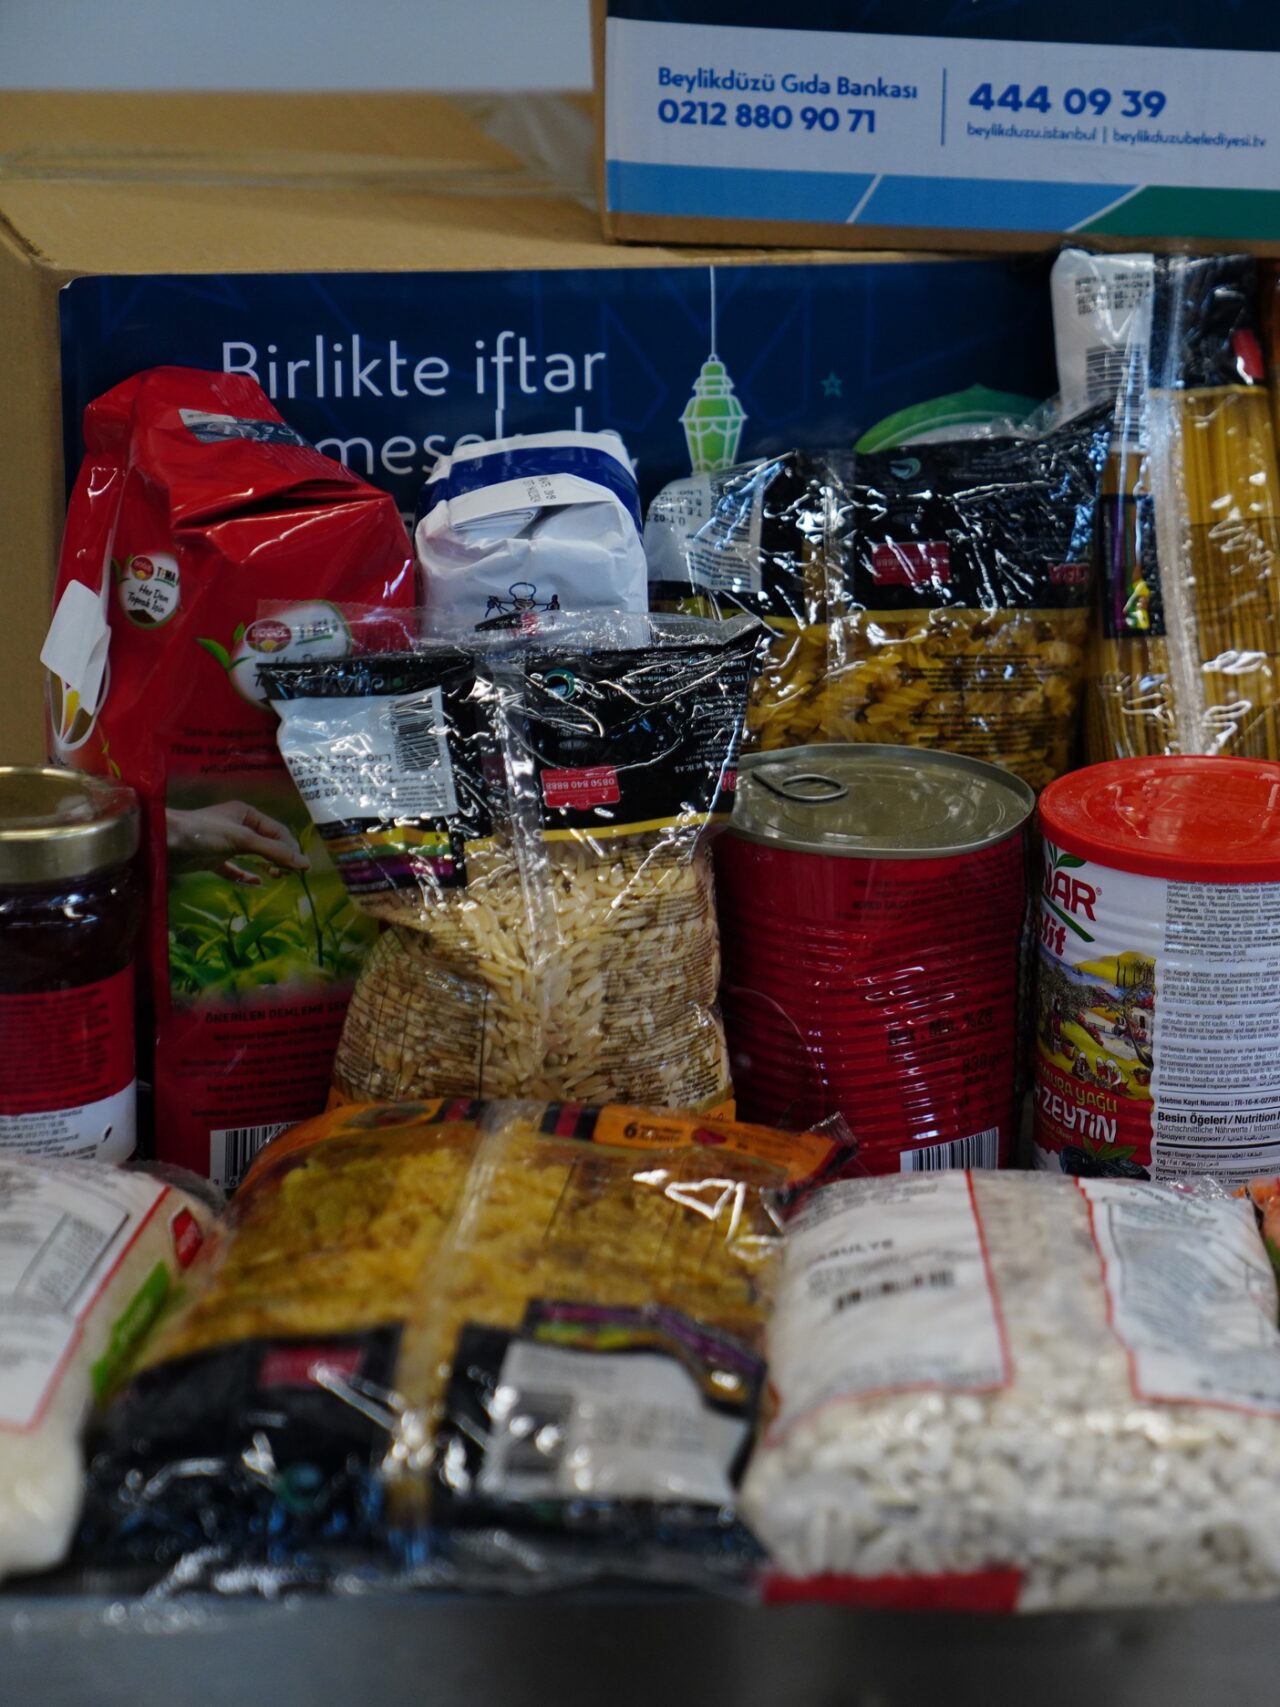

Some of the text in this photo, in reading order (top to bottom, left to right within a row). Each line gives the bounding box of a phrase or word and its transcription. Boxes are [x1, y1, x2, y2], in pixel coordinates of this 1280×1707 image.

[658, 66, 918, 99] Beylikdüzü Gıda Bankası
[968, 82, 1166, 118] 444 09 39
[658, 98, 875, 133] 0212 880 90 71
[967, 121, 1097, 142] beylikduzu.istanbul
[222, 331, 606, 406] Birlikte iftar
[1075, 1087, 1118, 1113] YAĞLI
[1157, 1111, 1187, 1124] Besin
[1189, 1111, 1228, 1127] Öğeleri
[1234, 1110, 1277, 1125] Nutrition
[1215, 1124, 1249, 1134] Nährwerte
